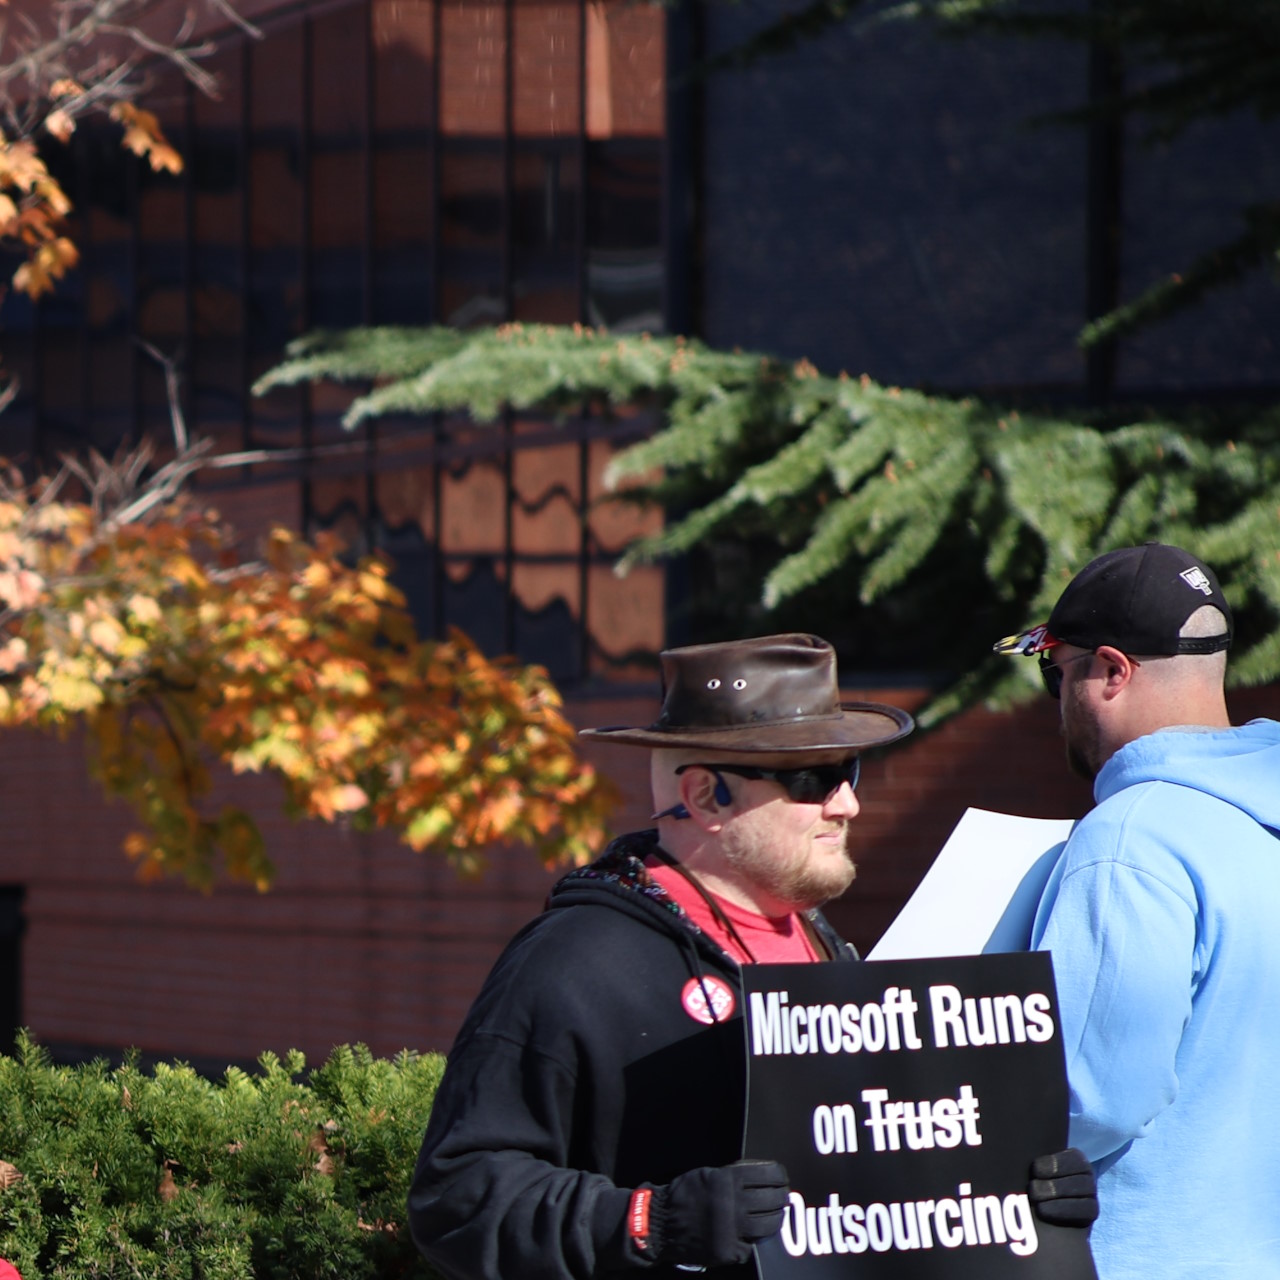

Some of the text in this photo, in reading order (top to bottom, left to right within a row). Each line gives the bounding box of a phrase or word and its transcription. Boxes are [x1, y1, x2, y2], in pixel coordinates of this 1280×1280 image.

[749, 986, 923, 1055] Microsoft
[929, 984, 1055, 1048] Runs
[813, 1085, 983, 1154] on Trust
[780, 1182, 1039, 1256] Outsourcing
